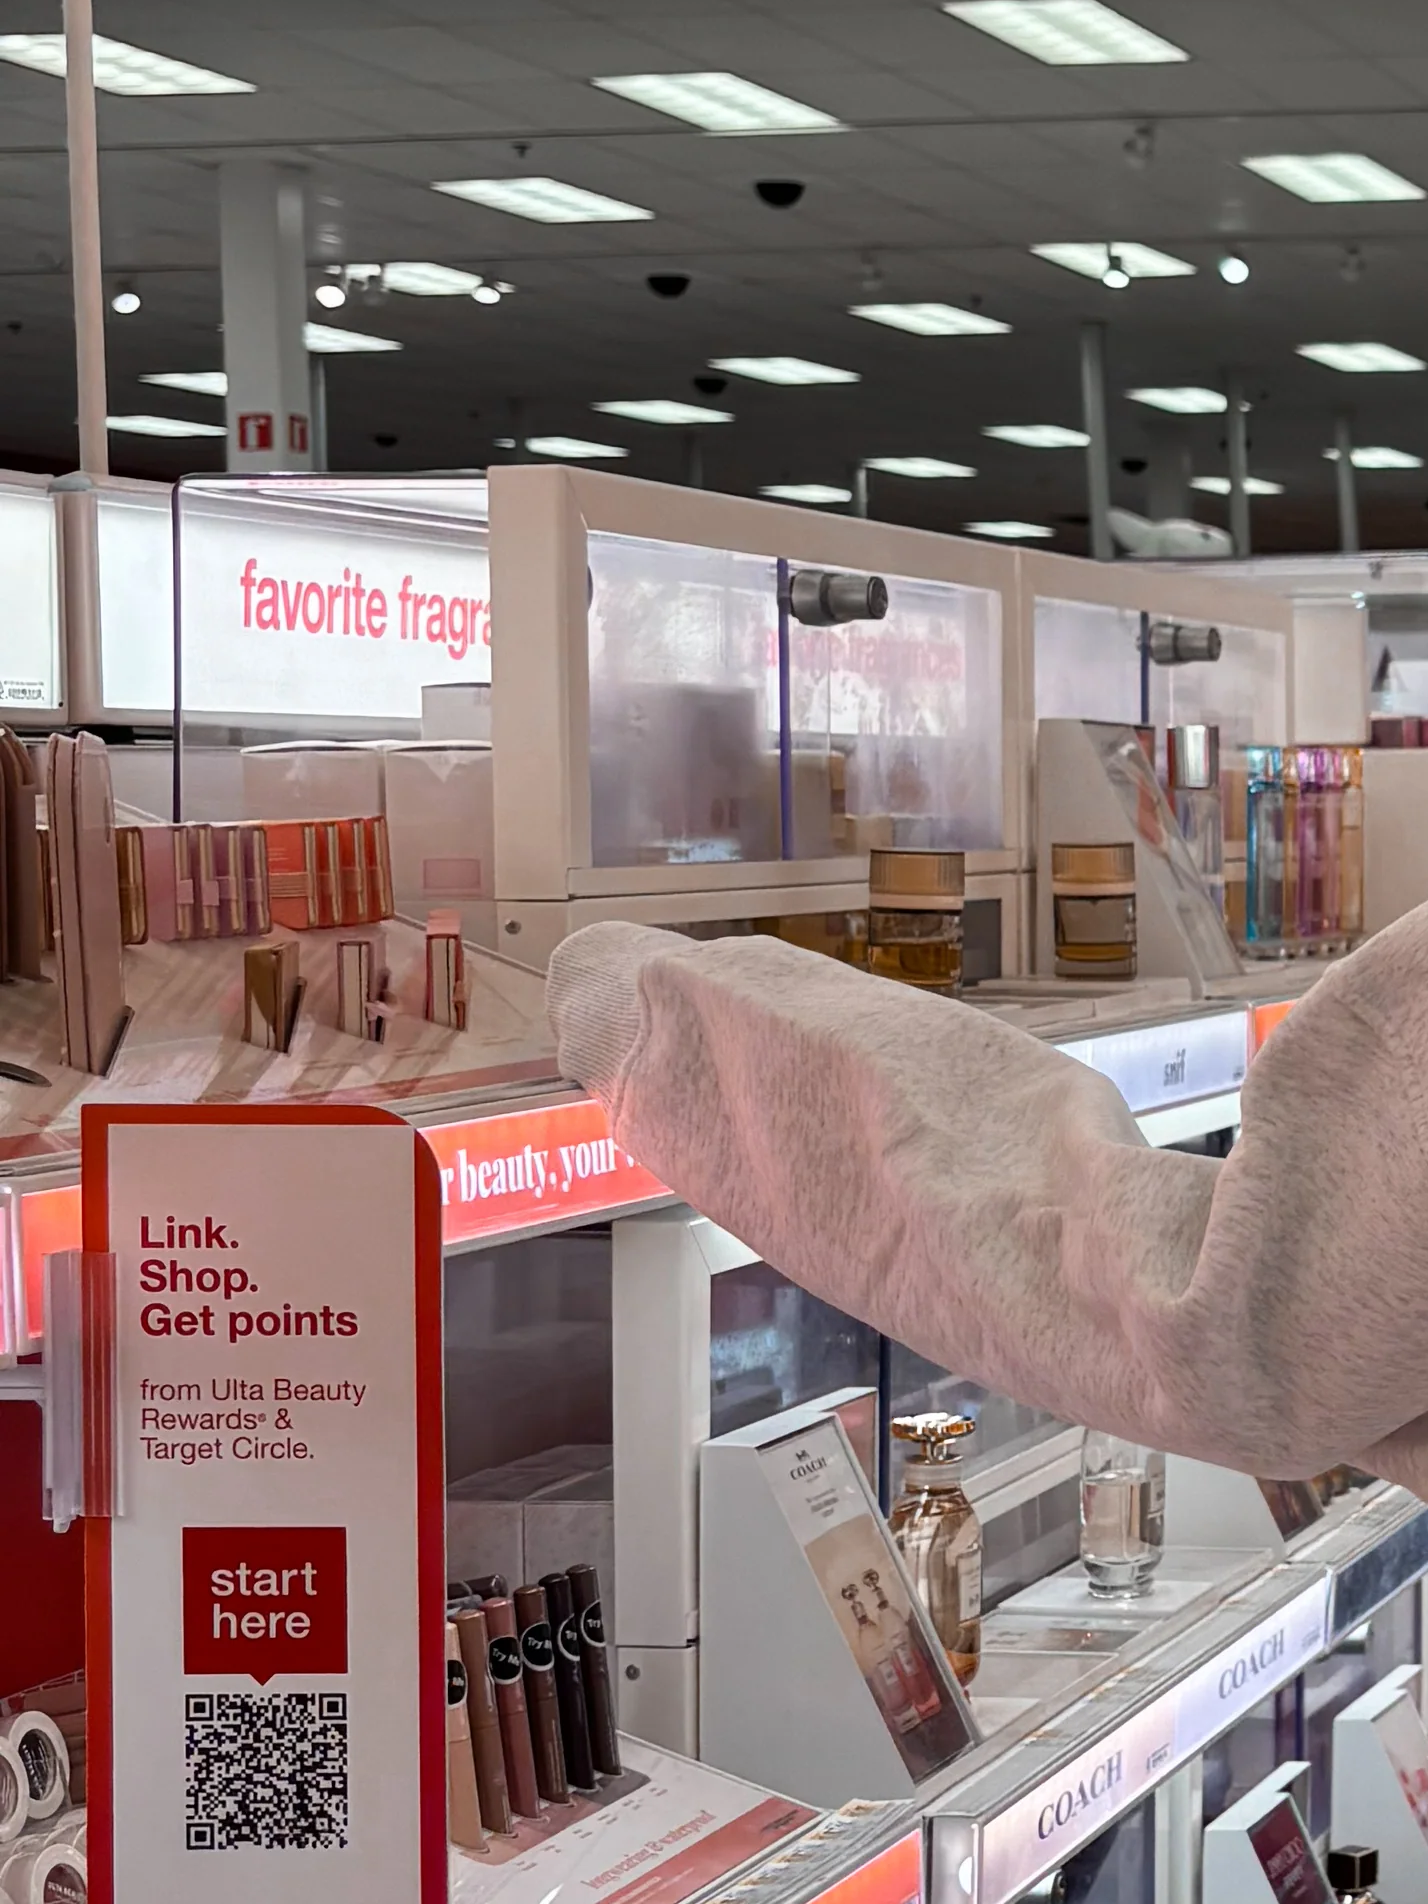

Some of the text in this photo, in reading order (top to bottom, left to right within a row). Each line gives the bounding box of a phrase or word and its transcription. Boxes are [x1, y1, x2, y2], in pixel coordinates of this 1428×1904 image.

[240, 558, 388, 639] favorite
[457, 1144, 557, 1202] beauty,
[140, 1216, 239, 1249] Link.
[140, 1259, 258, 1300] Shop.
[140, 1303, 358, 1344] Get points
[140, 1379, 366, 1407] from Ulta Beauty
[274, 1408, 294, 1430] &
[140, 1437, 315, 1465] Target Circle.
[211, 1562, 317, 1596] start
[213, 1603, 311, 1639] here
[492, 1647, 506, 1662] Try
[527, 1636, 543, 1650] Try
[1218, 1629, 1286, 1699] COACH
[1037, 1749, 1123, 1840] COACH
